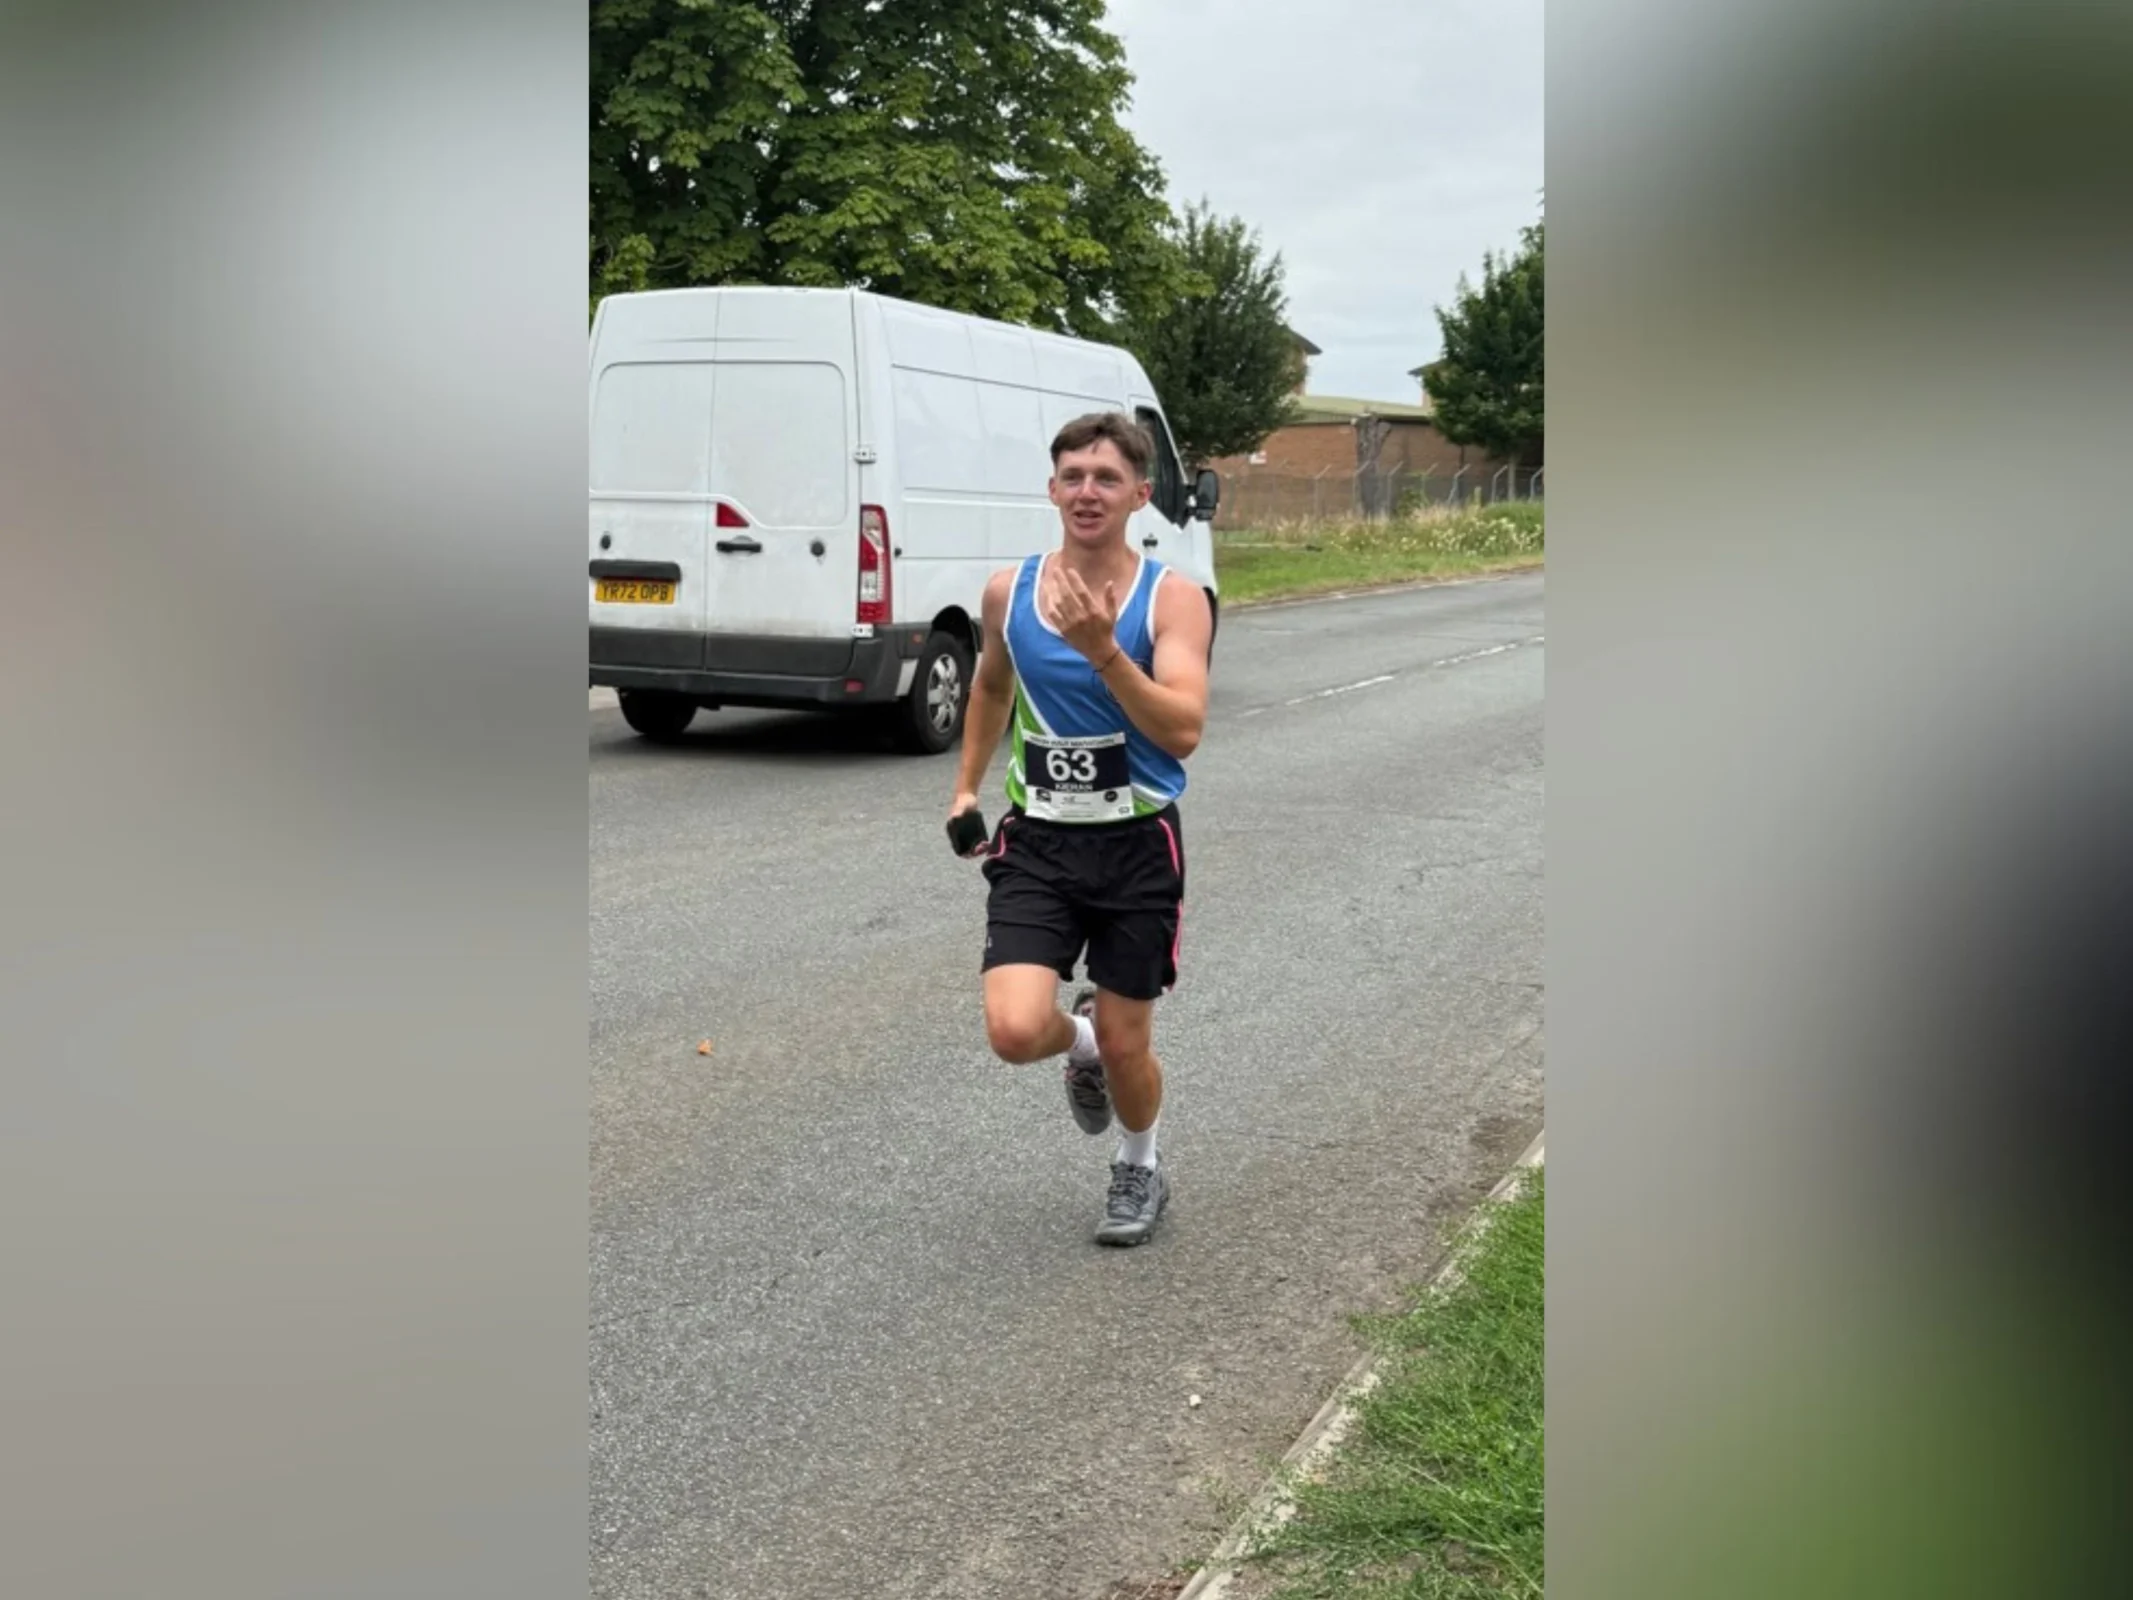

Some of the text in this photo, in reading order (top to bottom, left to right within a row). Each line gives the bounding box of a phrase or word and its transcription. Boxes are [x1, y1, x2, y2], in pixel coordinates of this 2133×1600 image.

[602, 582, 636, 599] YR72
[1046, 749, 1098, 782] 63
[1055, 782, 1093, 792] KIERAN
